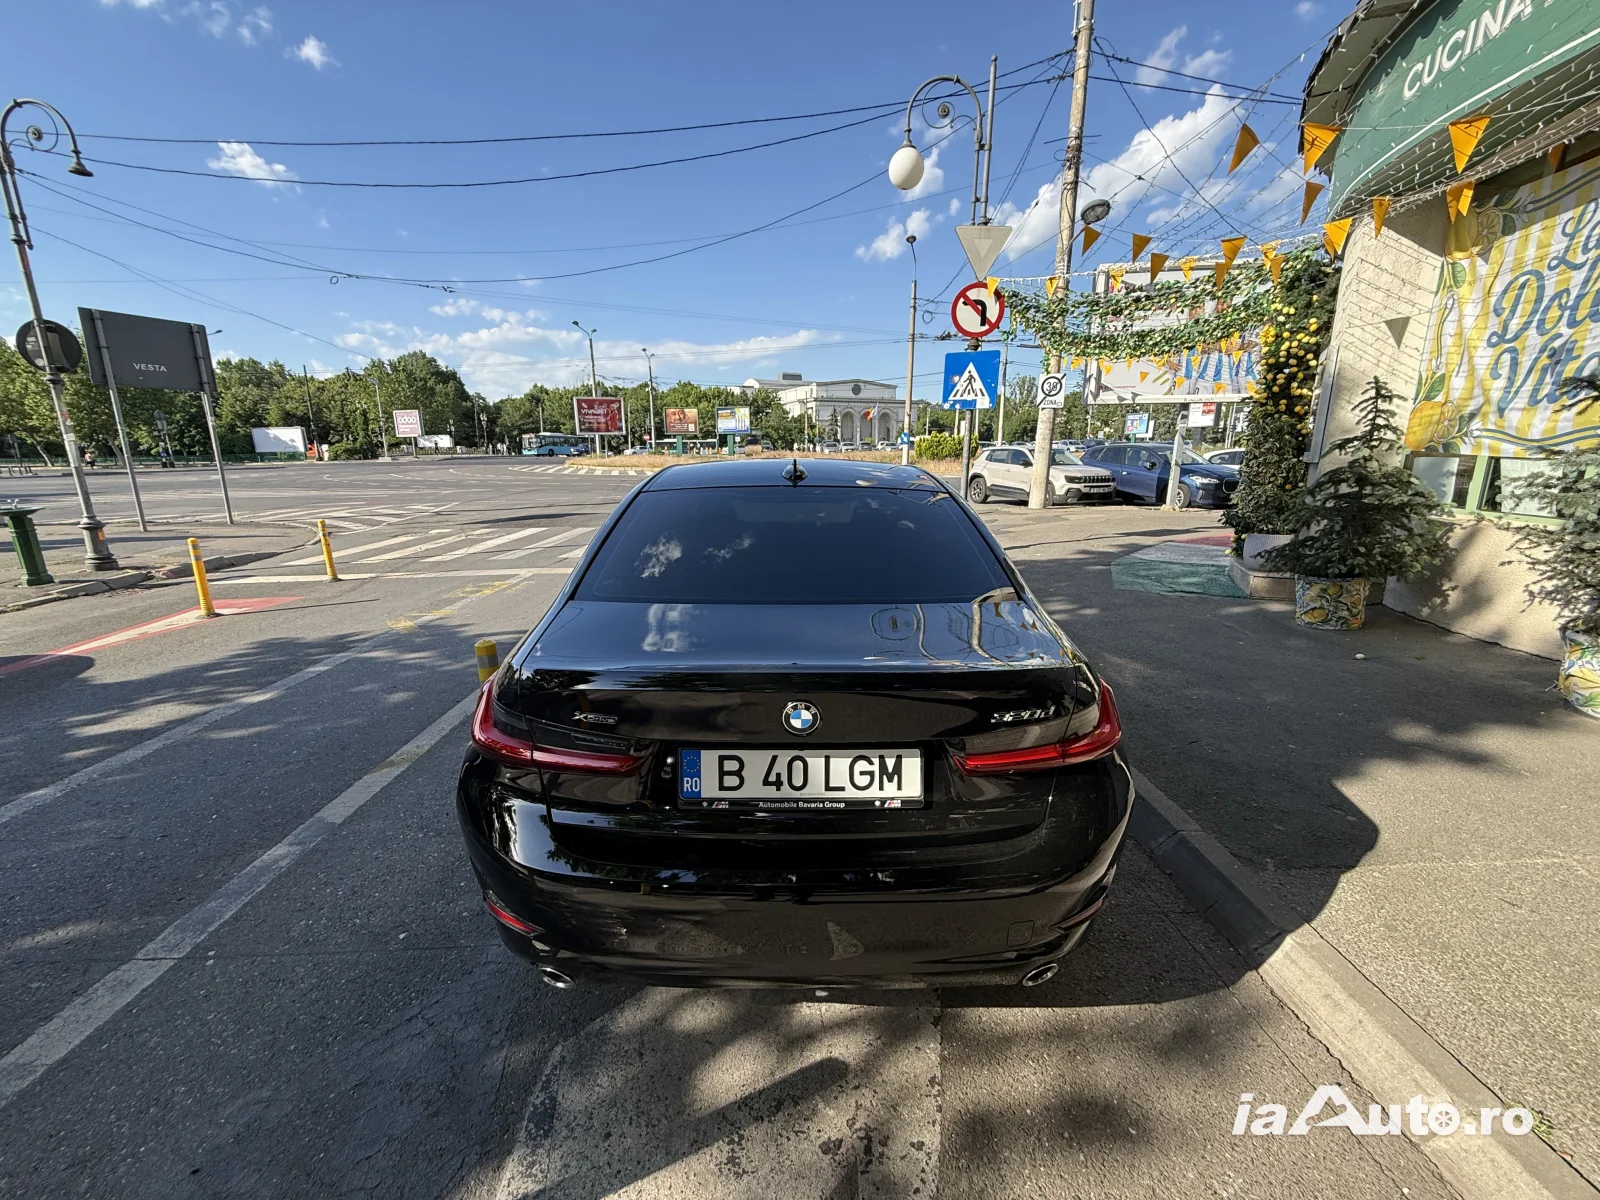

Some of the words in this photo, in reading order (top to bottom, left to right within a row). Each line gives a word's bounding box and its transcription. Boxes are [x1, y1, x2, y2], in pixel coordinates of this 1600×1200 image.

[1402, 0, 1533, 101] CUCINA
[133, 362, 168, 373] VESTA
[1046, 381, 1058, 392] 30
[398, 414, 416, 424] odoo
[717, 754, 745, 791] B
[762, 754, 809, 791] 40
[823, 754, 903, 791] LGM
[683, 777, 700, 792] RO
[758, 801, 797, 809] Automobile
[798, 801, 823, 809] Bavaria
[824, 801, 845, 810] Group
